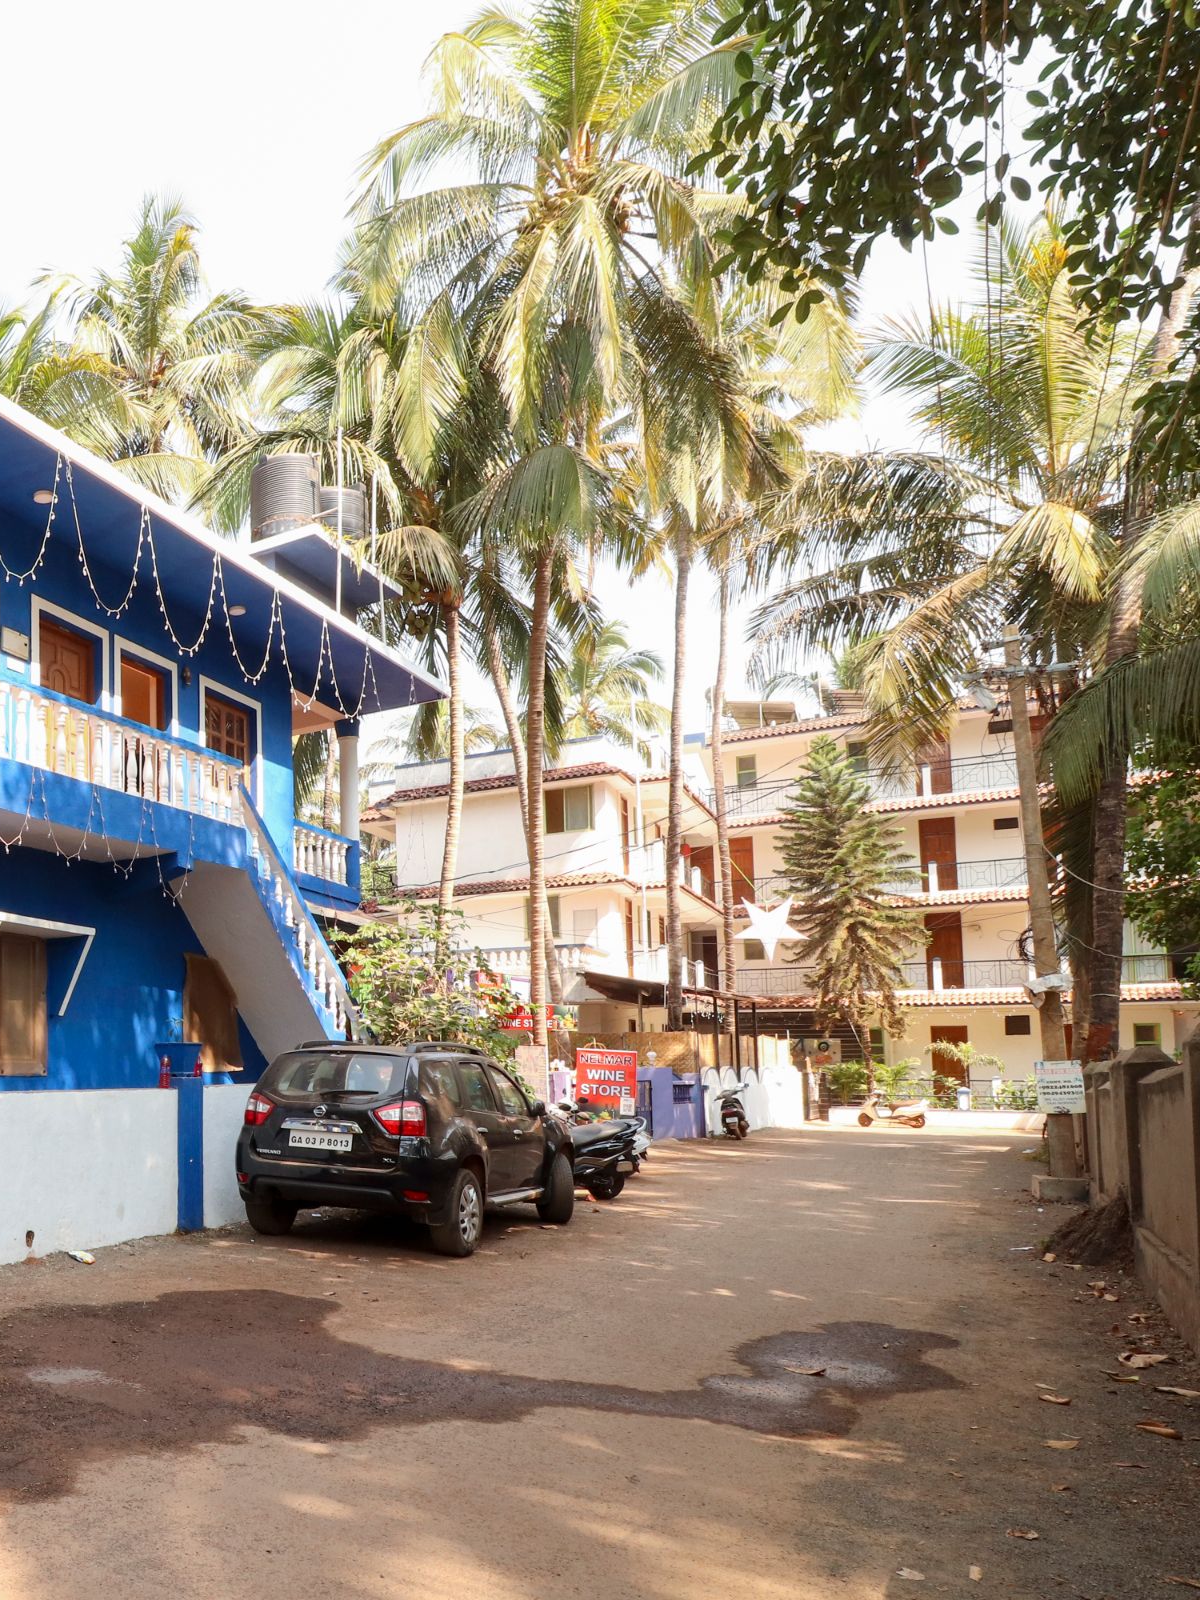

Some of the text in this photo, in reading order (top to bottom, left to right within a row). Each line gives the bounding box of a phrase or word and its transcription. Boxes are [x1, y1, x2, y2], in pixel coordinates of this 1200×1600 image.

[523, 1018, 553, 1029] STE
[579, 1053, 633, 1066] NELMAR
[586, 1068, 625, 1082] WINE
[580, 1083, 631, 1098] STORE
[291, 1135, 350, 1148] GA 03 P 8013
